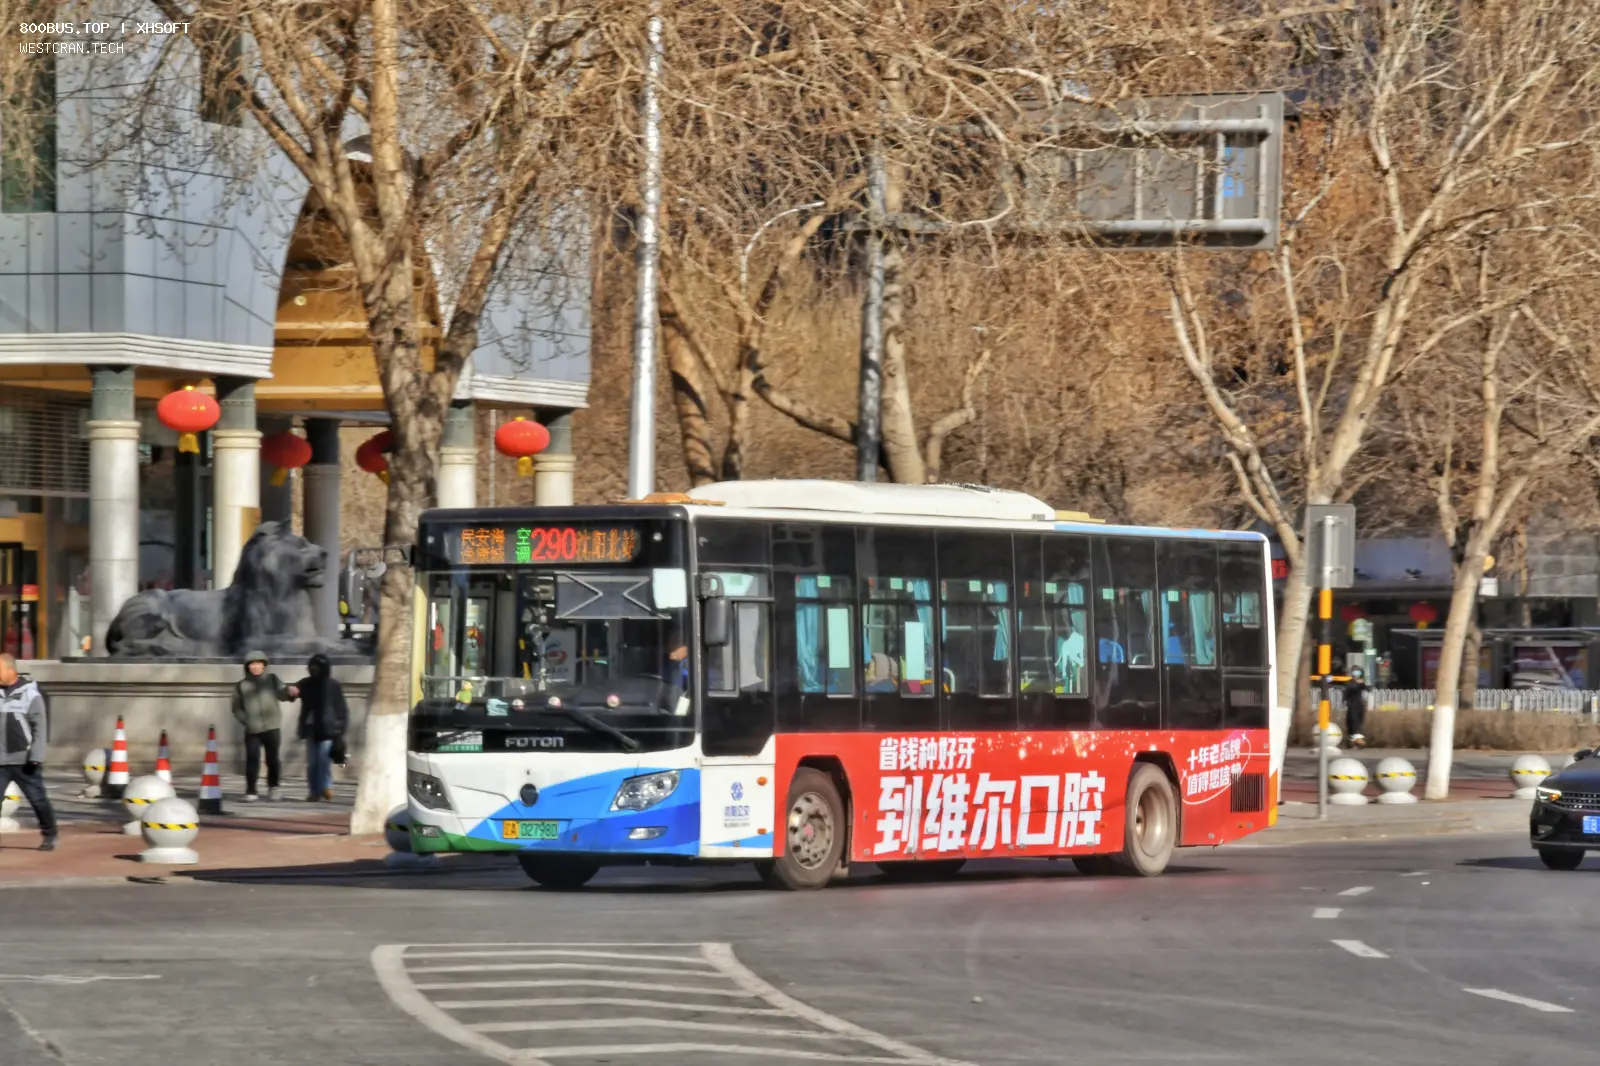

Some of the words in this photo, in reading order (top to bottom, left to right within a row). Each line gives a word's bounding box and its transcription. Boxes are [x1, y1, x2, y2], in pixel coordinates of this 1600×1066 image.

[515, 527, 532, 563] 空调
[531, 527, 577, 561] 290
[505, 736, 564, 748] FOTON
[879, 737, 976, 771] 省钱种好牙
[1186, 738, 1241, 771] 十年老品牌
[873, 770, 1106, 855] 到维尔口腔
